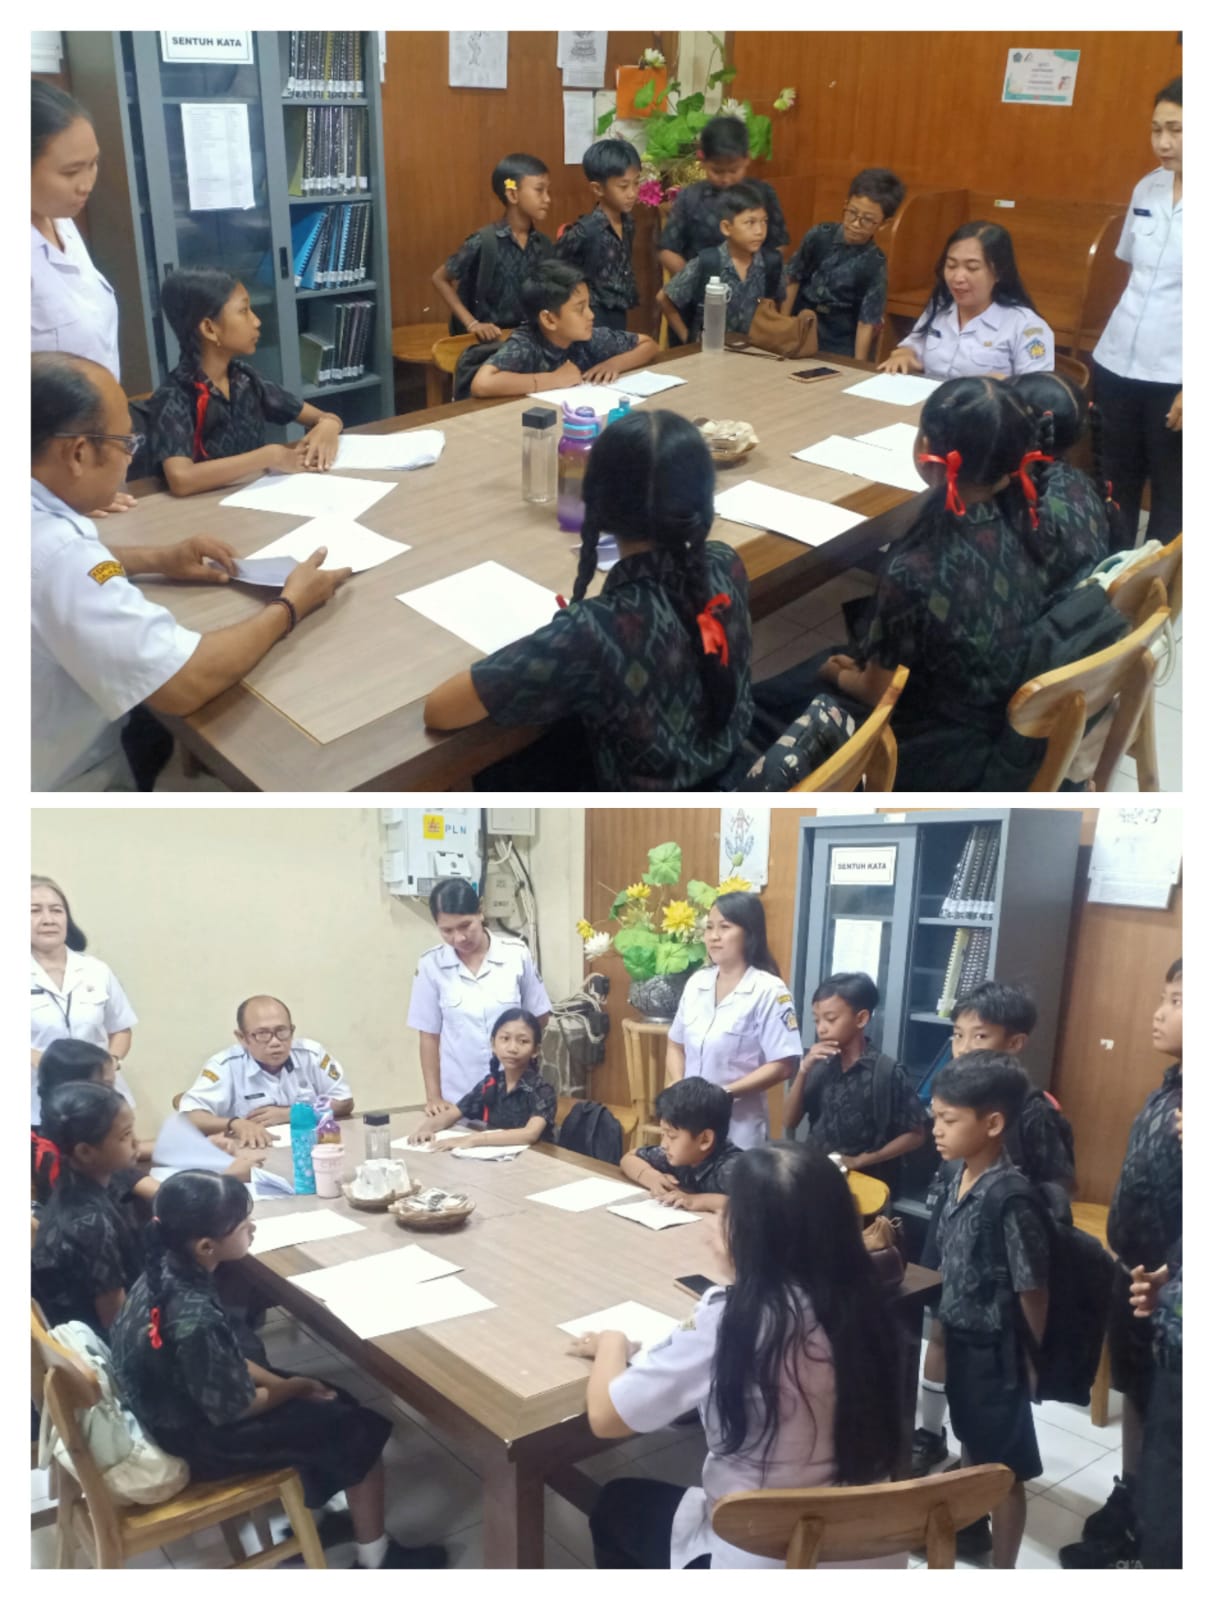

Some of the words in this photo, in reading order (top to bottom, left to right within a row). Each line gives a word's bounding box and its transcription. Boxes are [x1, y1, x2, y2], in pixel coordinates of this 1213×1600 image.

[172, 36, 214, 46] SENTUH
[216, 38, 242, 47] KATA
[445, 824, 466, 834] PLN
[867, 862, 886, 870] KATA
